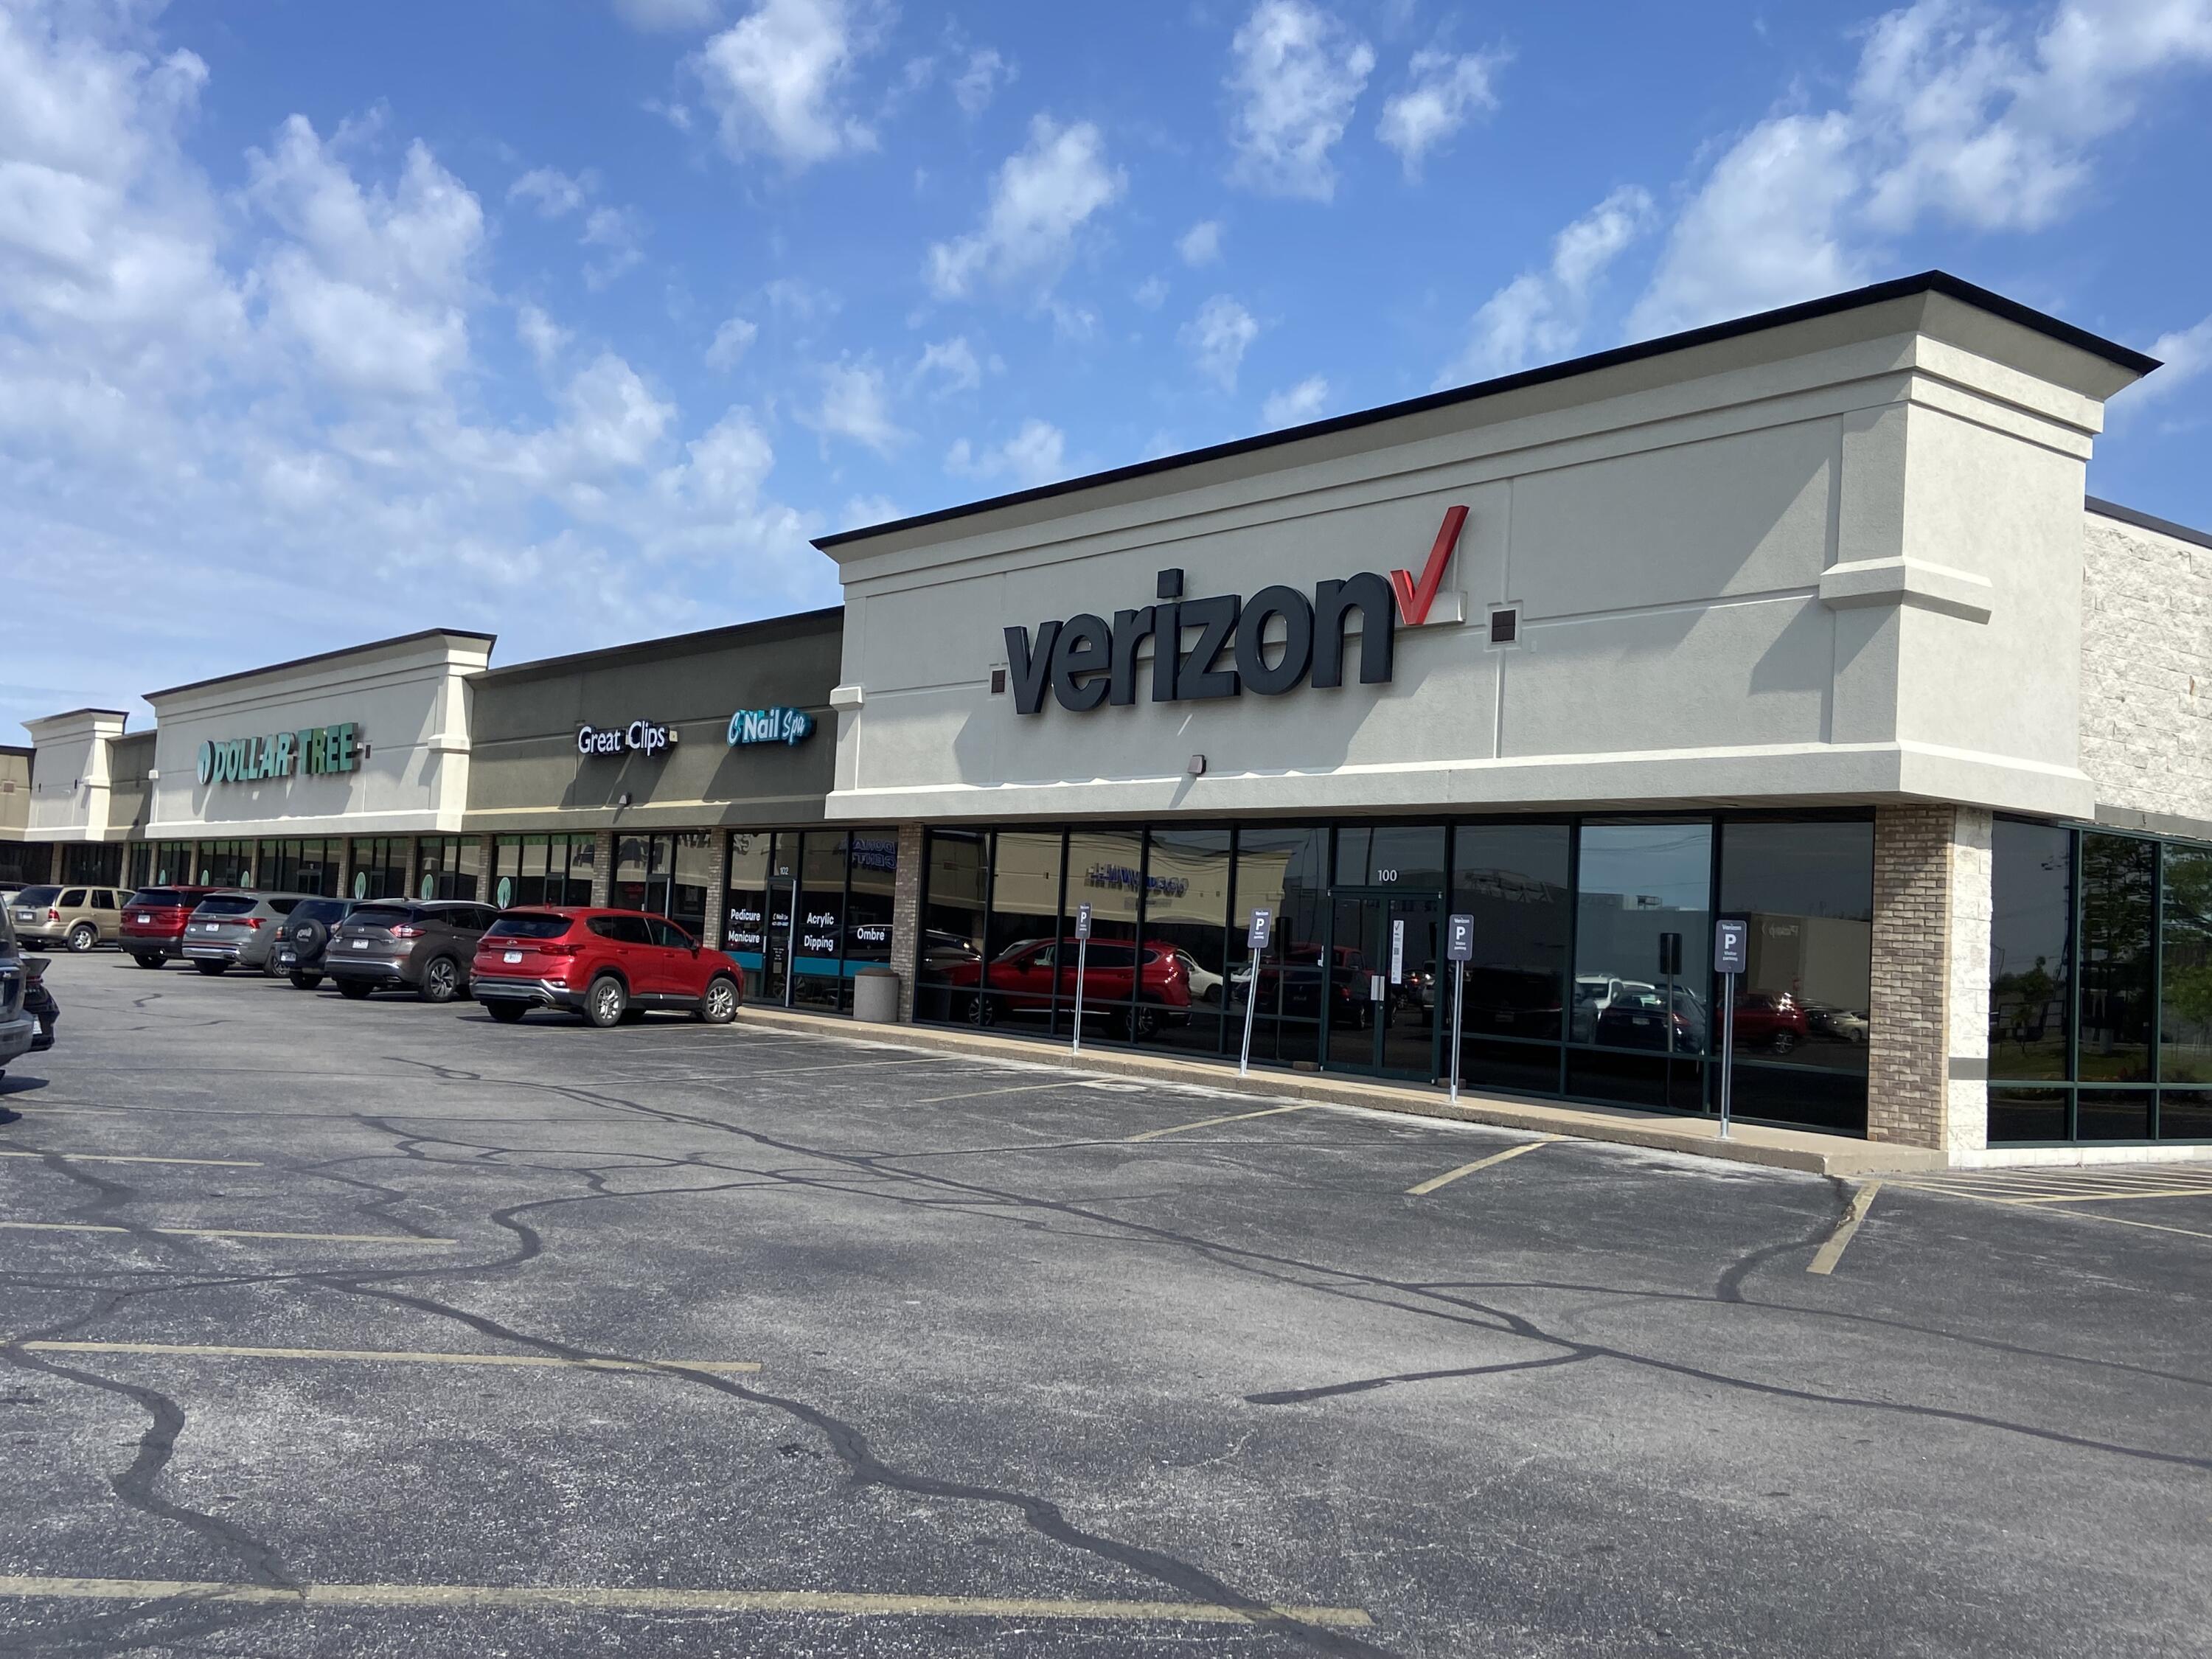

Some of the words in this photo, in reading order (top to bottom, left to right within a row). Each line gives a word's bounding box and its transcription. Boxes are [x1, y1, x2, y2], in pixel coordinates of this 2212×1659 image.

[1003, 568, 1396, 715] verizon
[744, 709, 779, 742] Nail
[782, 710, 805, 745] Spa
[578, 726, 621, 754] Great
[627, 720, 665, 757] Clips
[213, 731, 295, 783] DOLLAR
[297, 722, 359, 774] TREE
[779, 866, 789, 875] 102
[1377, 869, 1398, 882] 100
[730, 908, 761, 922] Pedicure
[806, 912, 835, 928] Acrylic
[1080, 911, 1088, 923] P
[1256, 918, 1265, 931] P
[728, 930, 760, 944] Manicure
[1456, 926, 1466, 940] P
[804, 935, 834, 952] Dipping
[1725, 933, 1736, 950] P
